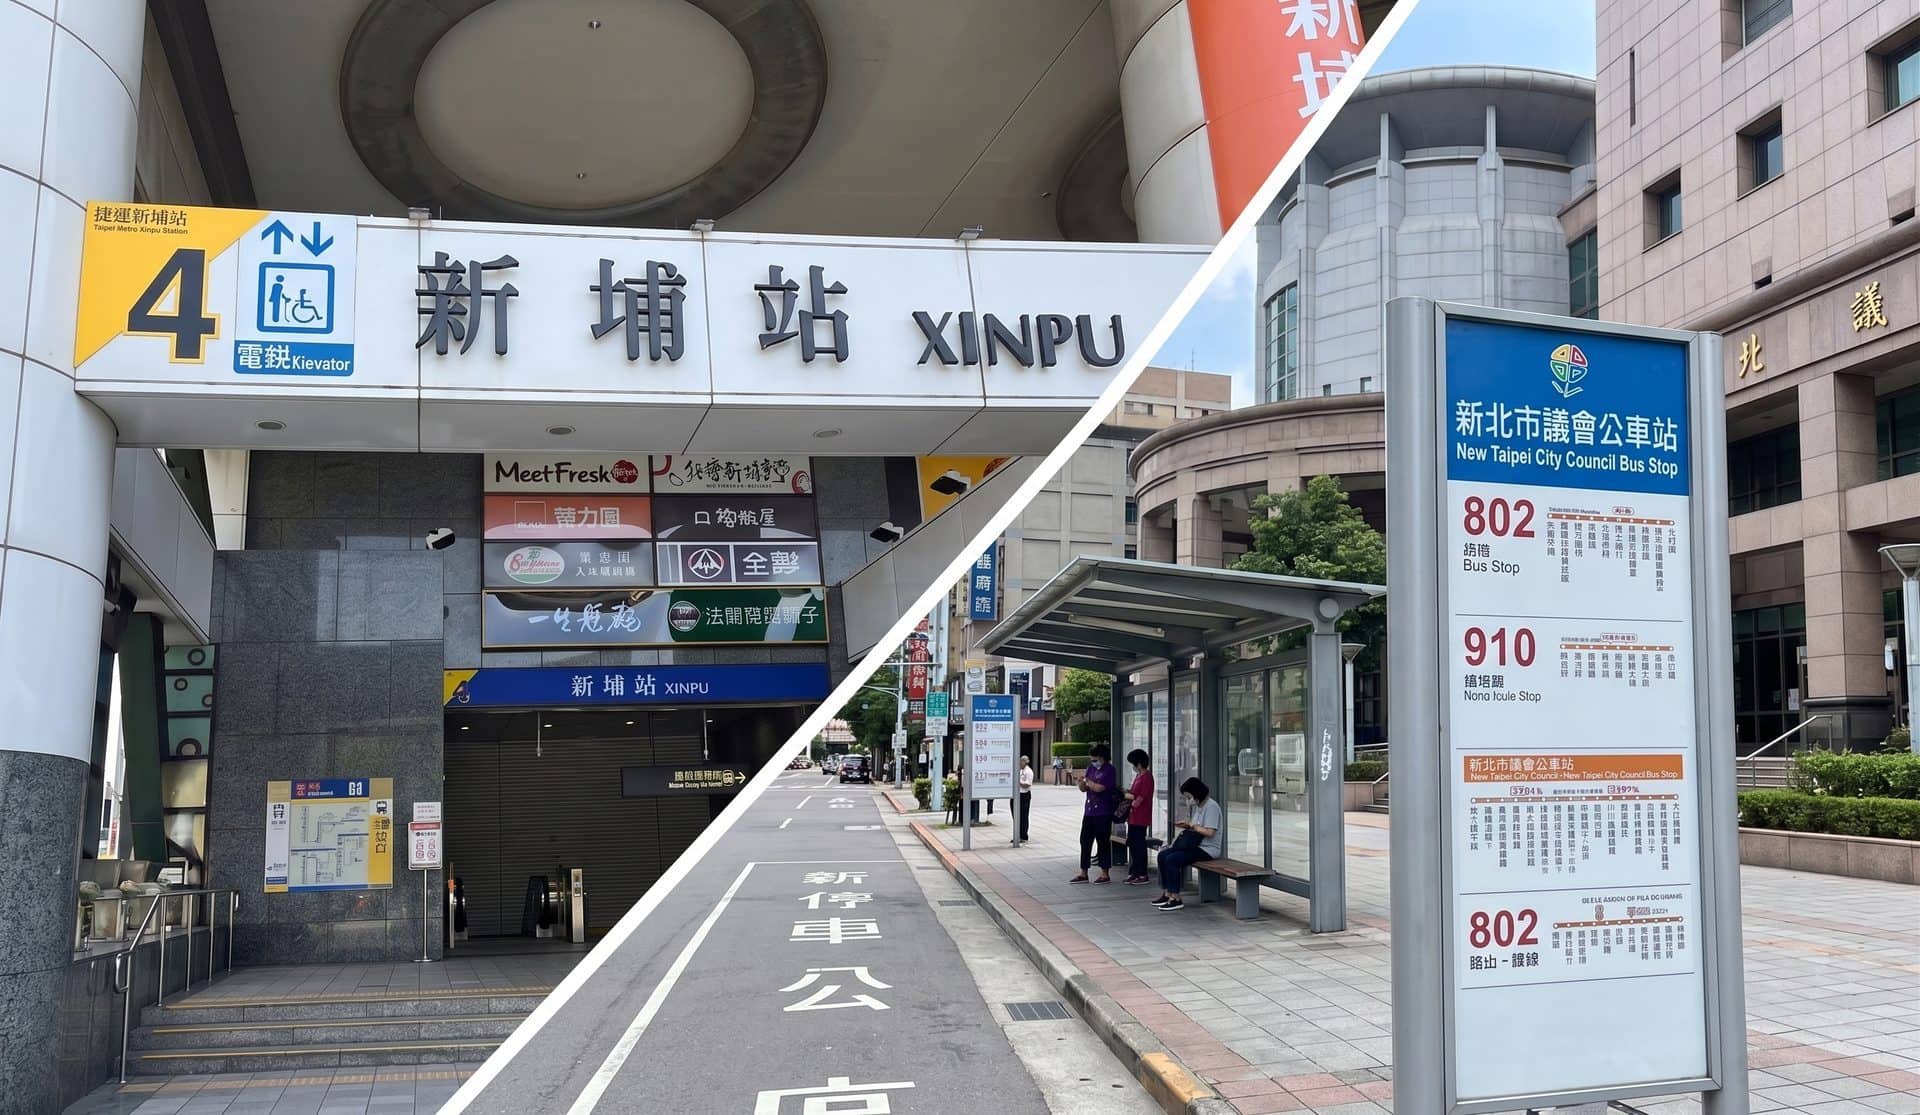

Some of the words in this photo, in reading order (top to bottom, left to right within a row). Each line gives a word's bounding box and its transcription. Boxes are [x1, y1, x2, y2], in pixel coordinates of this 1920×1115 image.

[94, 206, 188, 226] 捷運新埔站
[118, 225, 137, 234] Metro
[139, 226, 161, 235] Xinpu
[162, 227, 188, 235] Station
[127, 247, 217, 361] 4
[415, 252, 849, 364] 新埔站
[911, 310, 1126, 369] XINPU
[1738, 333, 1765, 379] 北
[1850, 280, 1889, 332] 議
[1456, 399, 1678, 453] 新北市議會公車站
[1457, 442, 1487, 461] New
[1490, 444, 1531, 467] Taipei
[1536, 448, 1562, 471] City
[1566, 451, 1615, 470] Council
[1620, 456, 1645, 473] Bus
[1649, 457, 1678, 478] Stop
[1463, 496, 1535, 538] 802
[1464, 559, 1487, 572] Bus
[1491, 559, 1520, 576] Stop
[1464, 627, 1536, 667] 910
[571, 674, 656, 698] 新埔站
[664, 682, 709, 695] XINPU
[1519, 690, 1541, 703] Stop
[1469, 757, 1574, 773] 新北市議會公車站
[1470, 773, 1488, 781] New
[1513, 772, 1528, 781] City
[1604, 770, 1618, 780] City
[1646, 770, 1660, 778] Bus
[1469, 908, 1538, 949] 802
